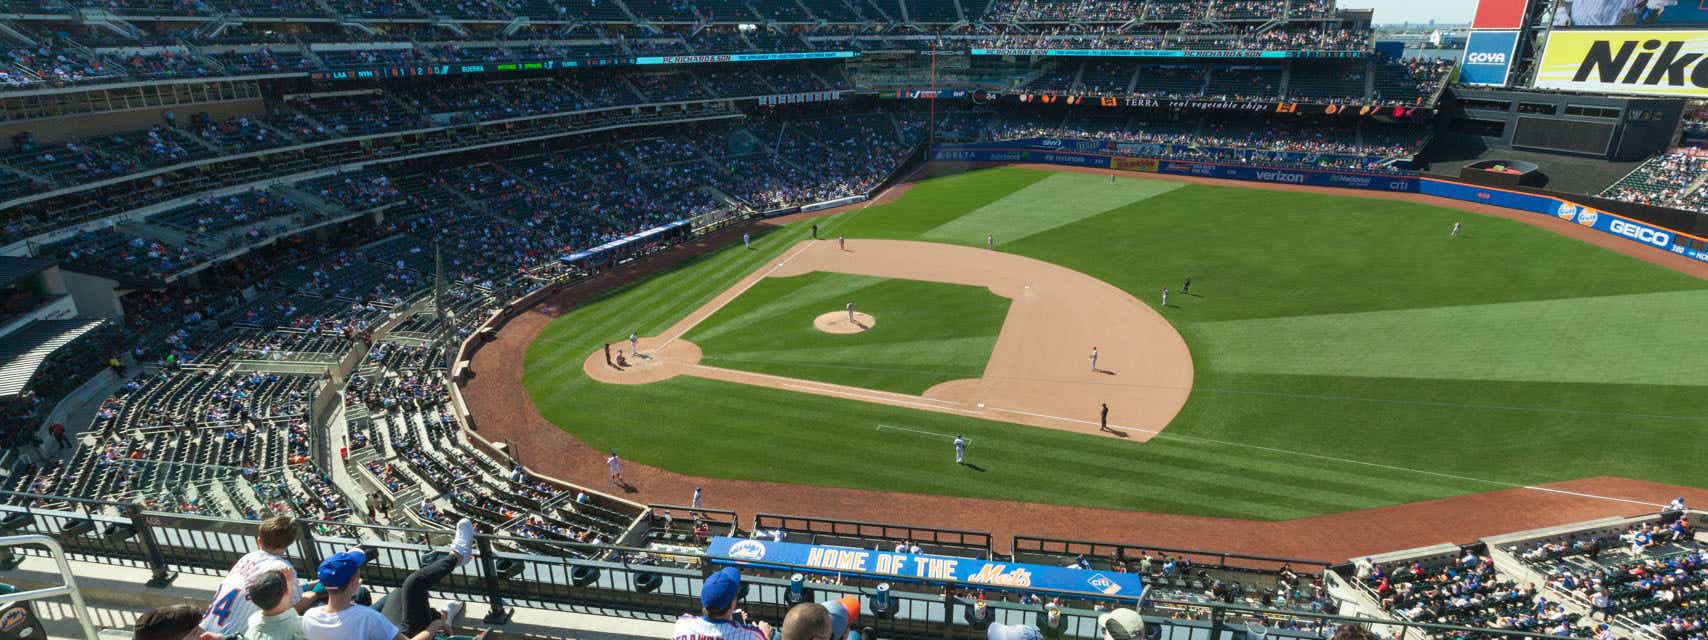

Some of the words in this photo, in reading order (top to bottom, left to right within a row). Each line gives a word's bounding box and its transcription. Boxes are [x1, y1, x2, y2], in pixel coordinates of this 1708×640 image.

[1468, 52, 1505, 64] GOYA
[417, 67, 423, 75] 2
[1125, 98, 1159, 107] TERRA
[1192, 100, 1238, 110] vegetable
[1241, 103, 1268, 112] chips
[1257, 170, 1304, 182] verizon
[1560, 208, 1576, 216] Gulf
[1579, 213, 1597, 222] Gulf
[1609, 219, 1670, 247] GEICO
[807, 547, 870, 572] HOME
[876, 554, 908, 576] OF
[914, 556, 958, 581] THE
[967, 563, 1031, 587] Mets
